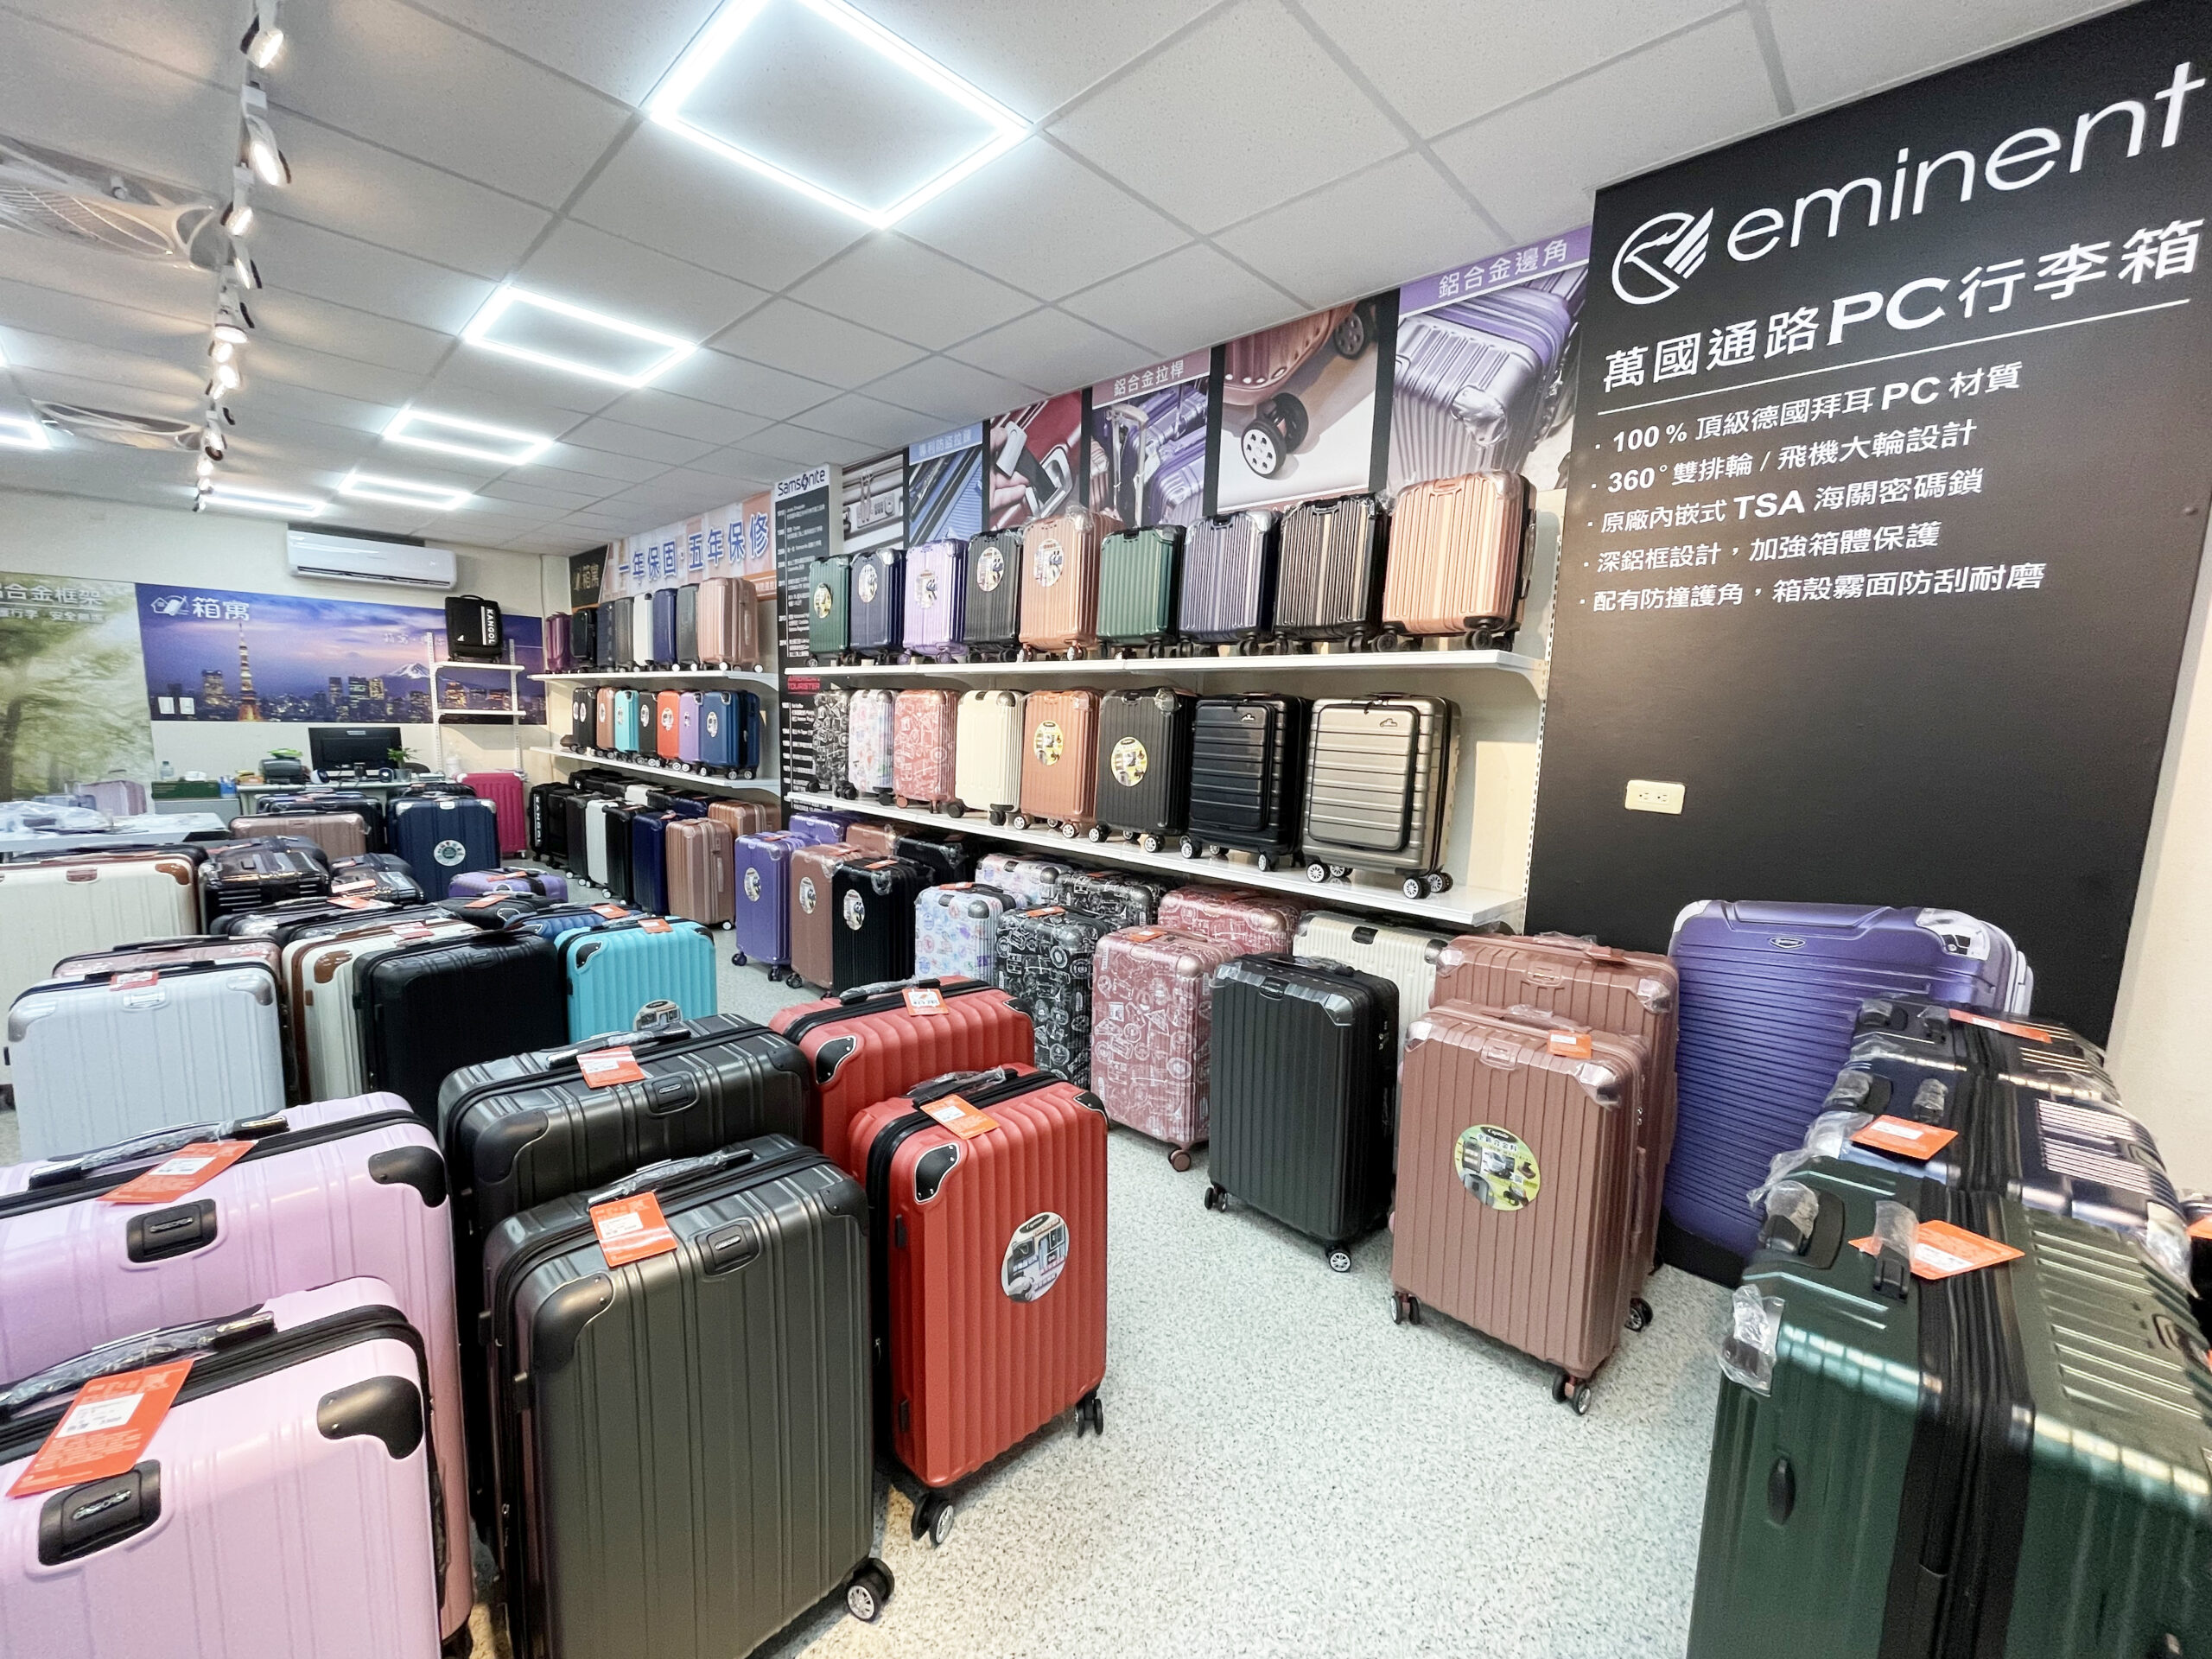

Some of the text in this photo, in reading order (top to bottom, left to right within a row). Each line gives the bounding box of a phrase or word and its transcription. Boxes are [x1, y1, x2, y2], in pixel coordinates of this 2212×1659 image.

[1727, 62, 2205, 261] eminent
[1439, 239, 1567, 298] 鋁合金邊角
[1604, 219, 2205, 392] 萬國通路PC行李箱
[1114, 359, 1184, 397] 鋁合金拉桿
[778, 469, 825, 496] Samsonite
[1733, 490, 1805, 519] TSA
[486, 608, 497, 645] KANGOL
